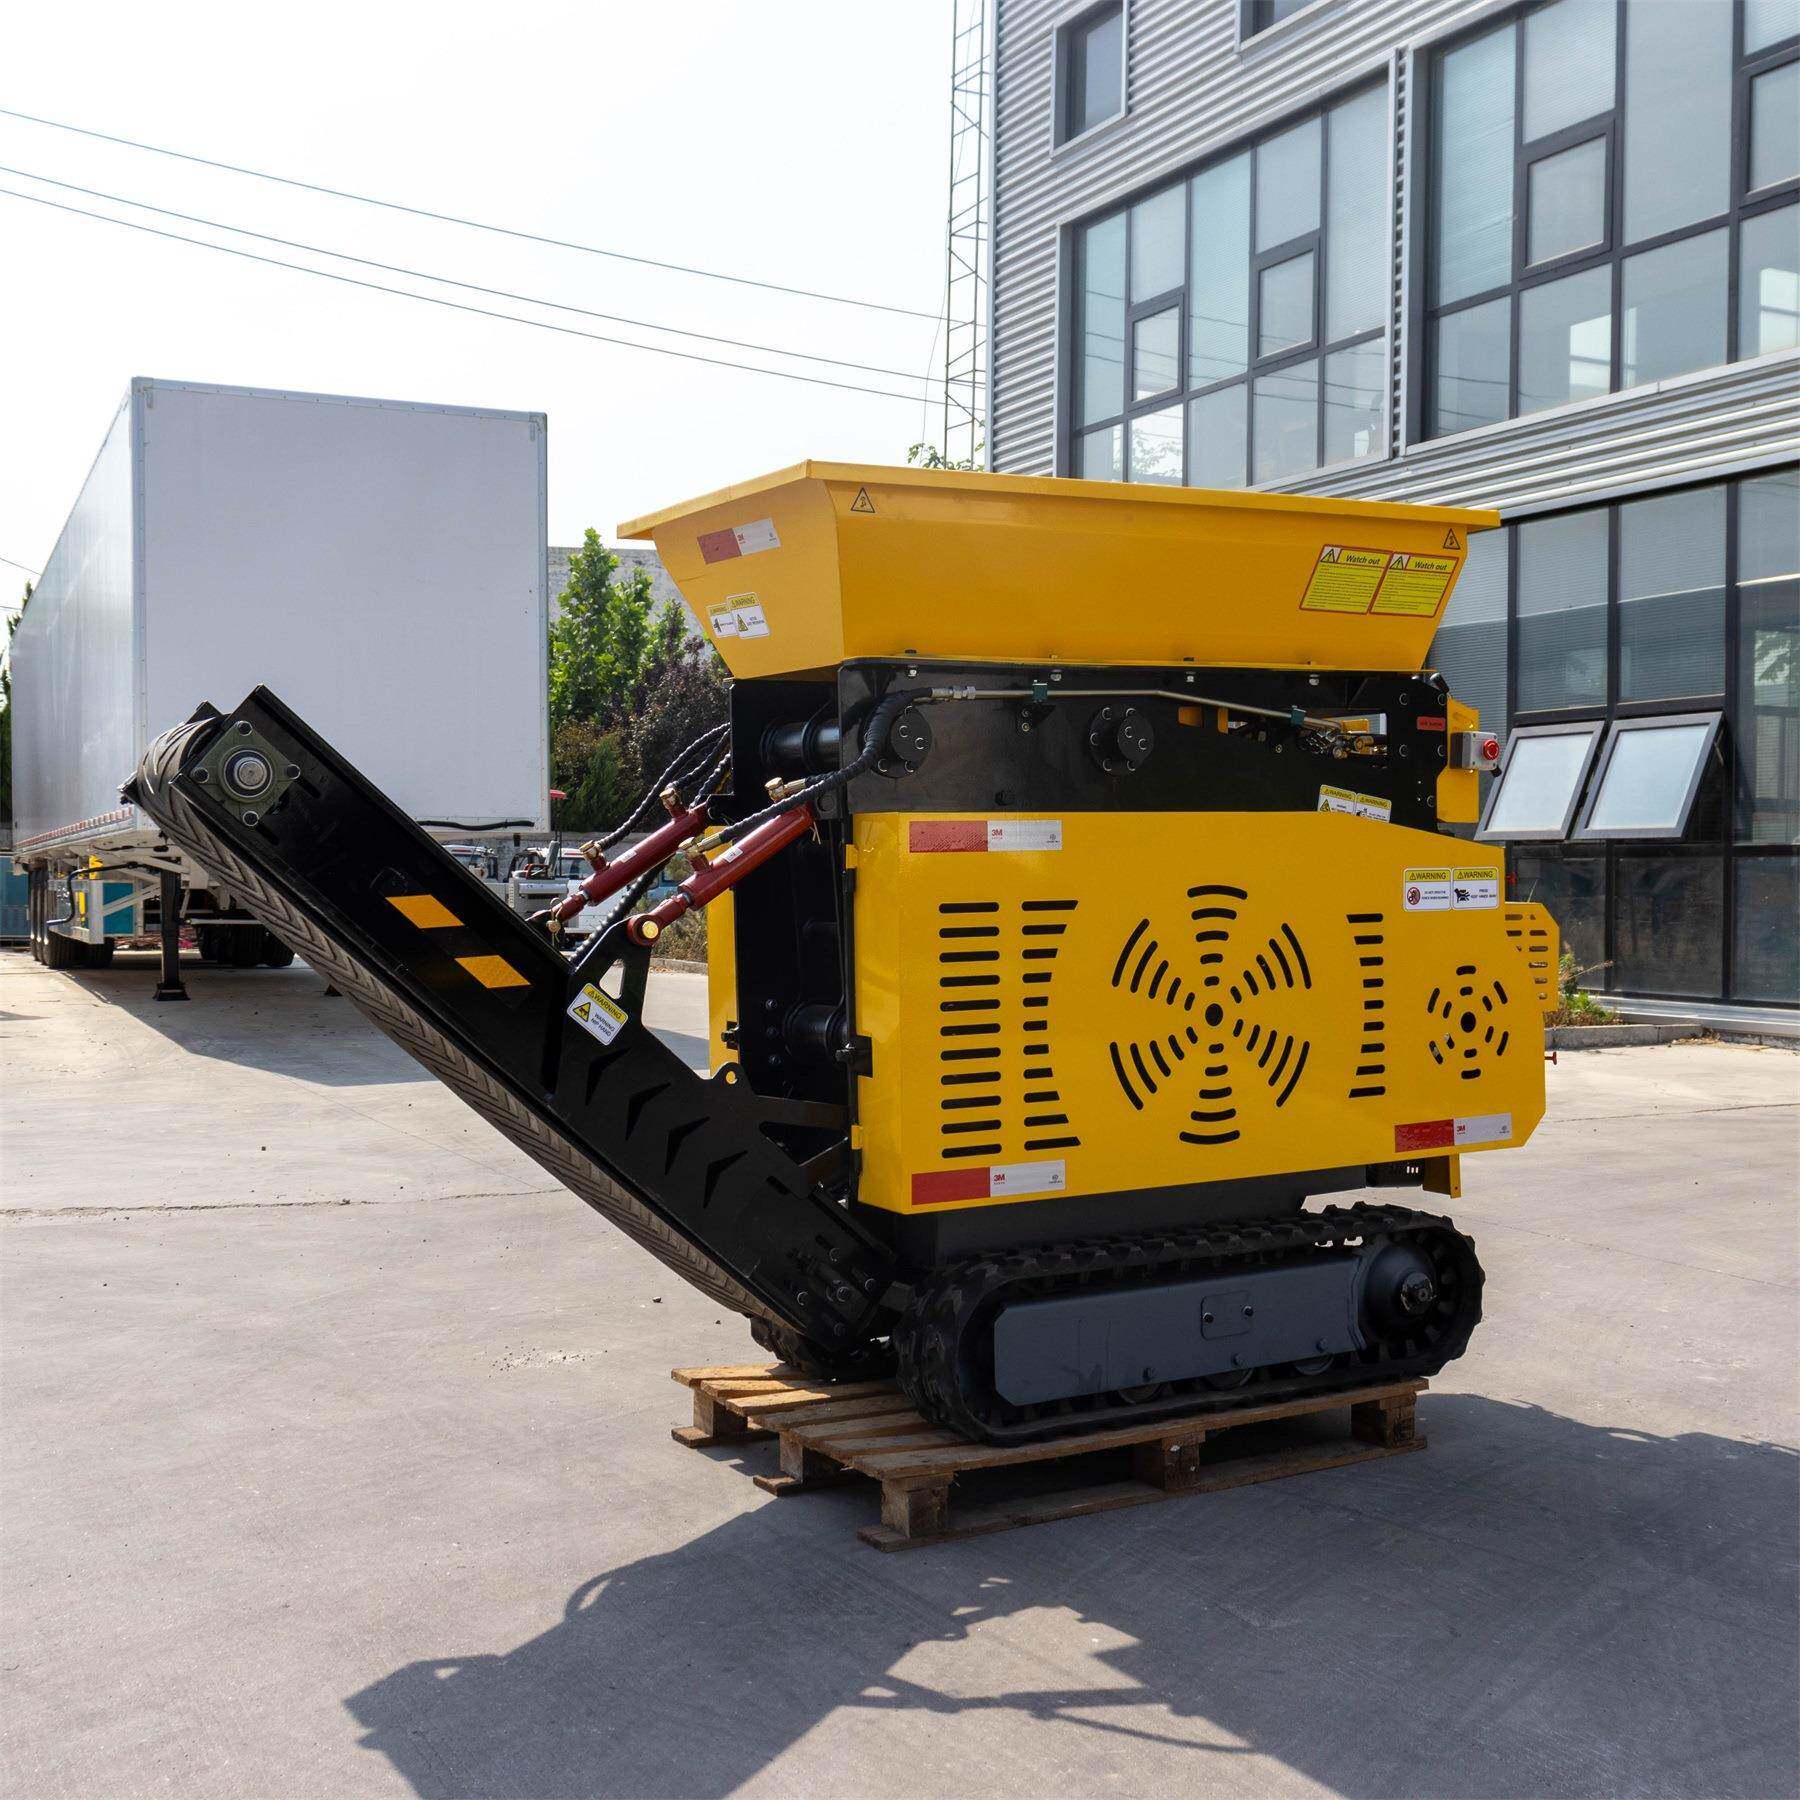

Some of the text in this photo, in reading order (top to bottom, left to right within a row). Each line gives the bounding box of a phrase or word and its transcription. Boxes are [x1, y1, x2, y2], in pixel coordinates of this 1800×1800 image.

[1345, 554, 1381, 565] Watch out
[1414, 560, 1448, 571] Watch out
[1329, 790, 1352, 800] WARNING
[1365, 797, 1388, 808] WARNING
[991, 829, 1003, 837] 3M
[1416, 872, 1447, 880] WARNING
[1463, 871, 1493, 879] WARNING
[594, 994, 622, 1020] WARNING
[594, 1012, 616, 1032] WARNING
[598, 1025, 612, 1037] HAND
[993, 1173, 1005, 1182] 3M
